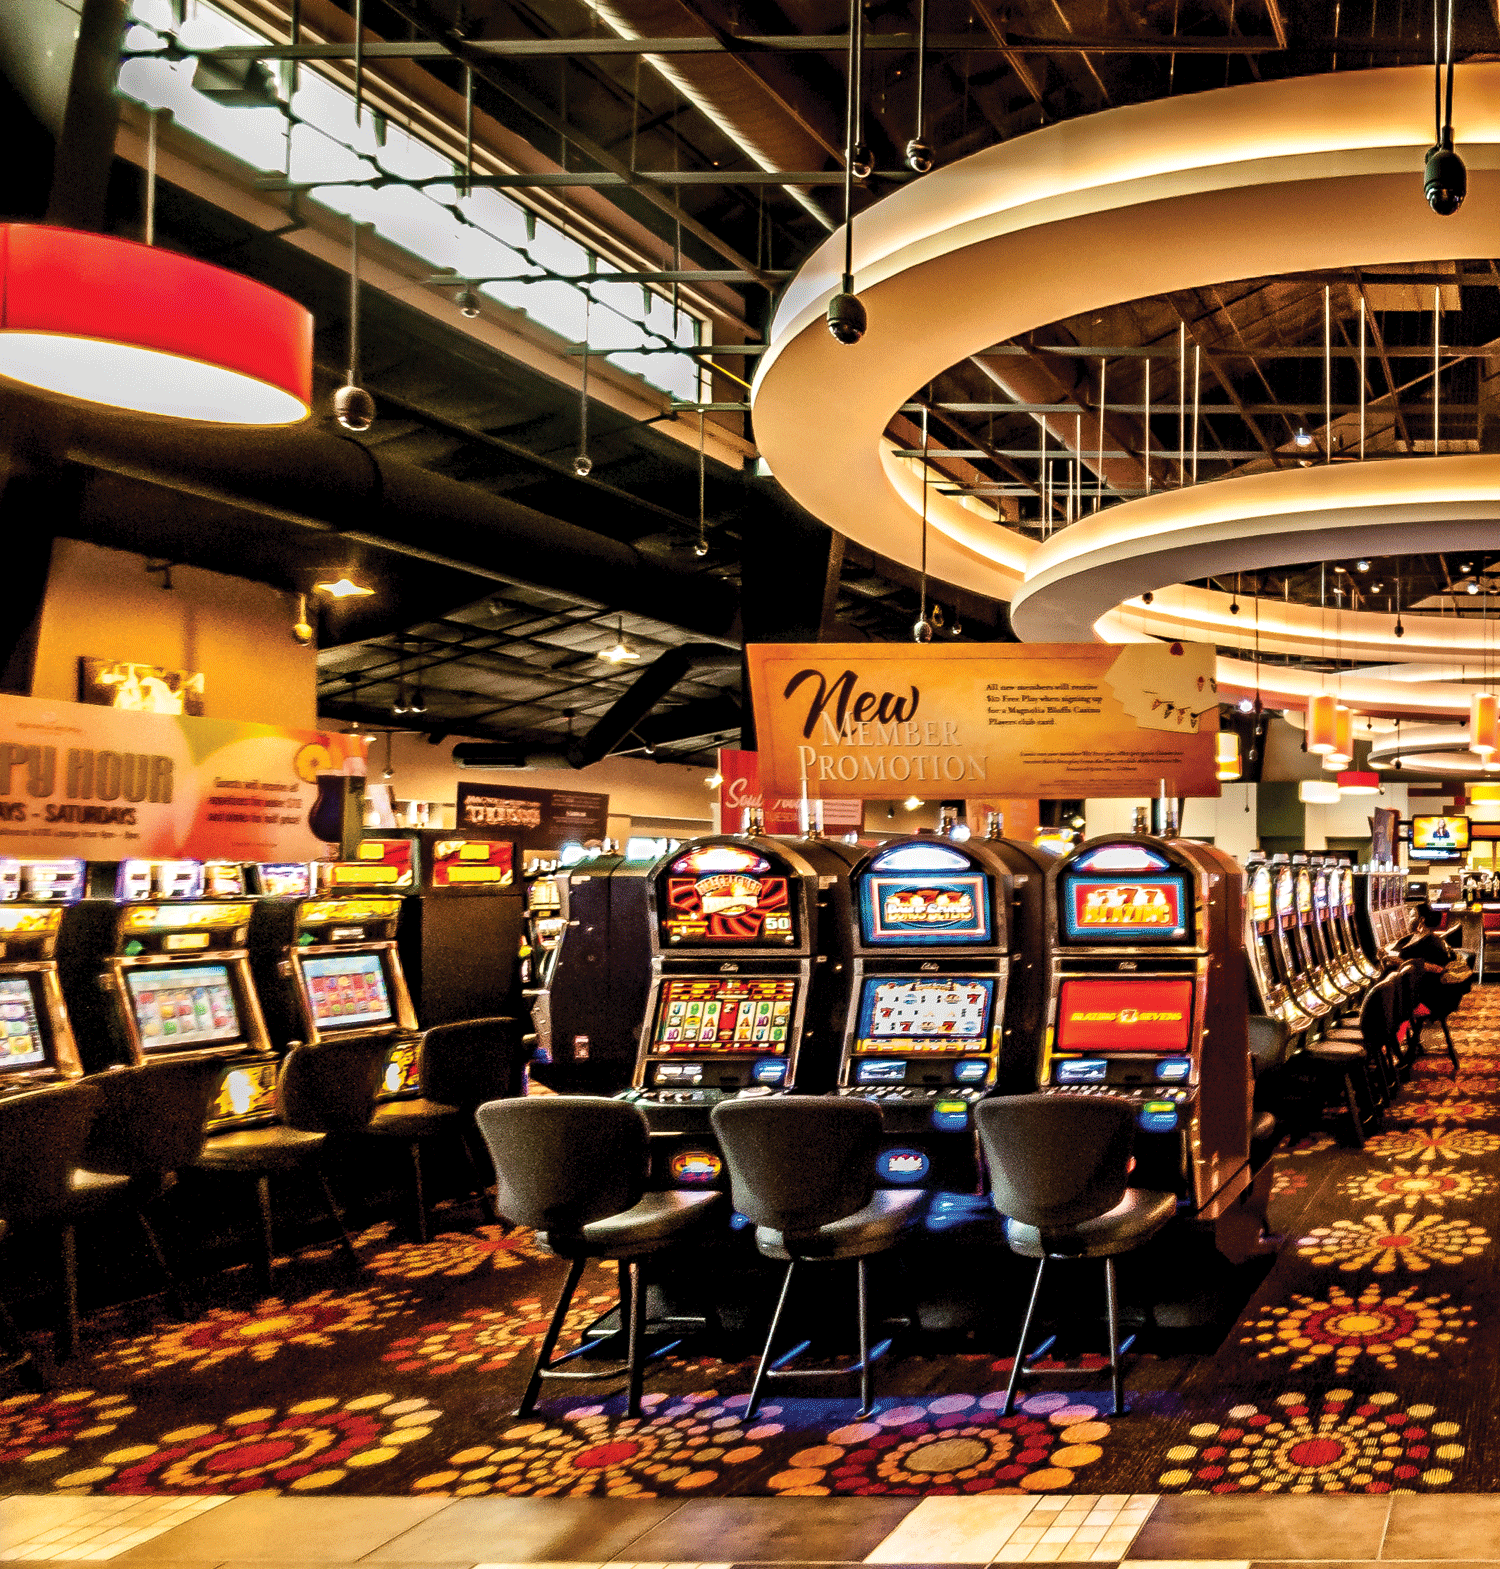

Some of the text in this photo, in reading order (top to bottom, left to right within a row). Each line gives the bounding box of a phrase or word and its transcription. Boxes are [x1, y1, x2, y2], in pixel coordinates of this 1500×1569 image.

[783, 669, 919, 739] New
[821, 712, 962, 747] MEMBER
[66, 747, 174, 804] HOUR
[798, 746, 988, 782] PROMOTION
[765, 917, 792, 930] 50
